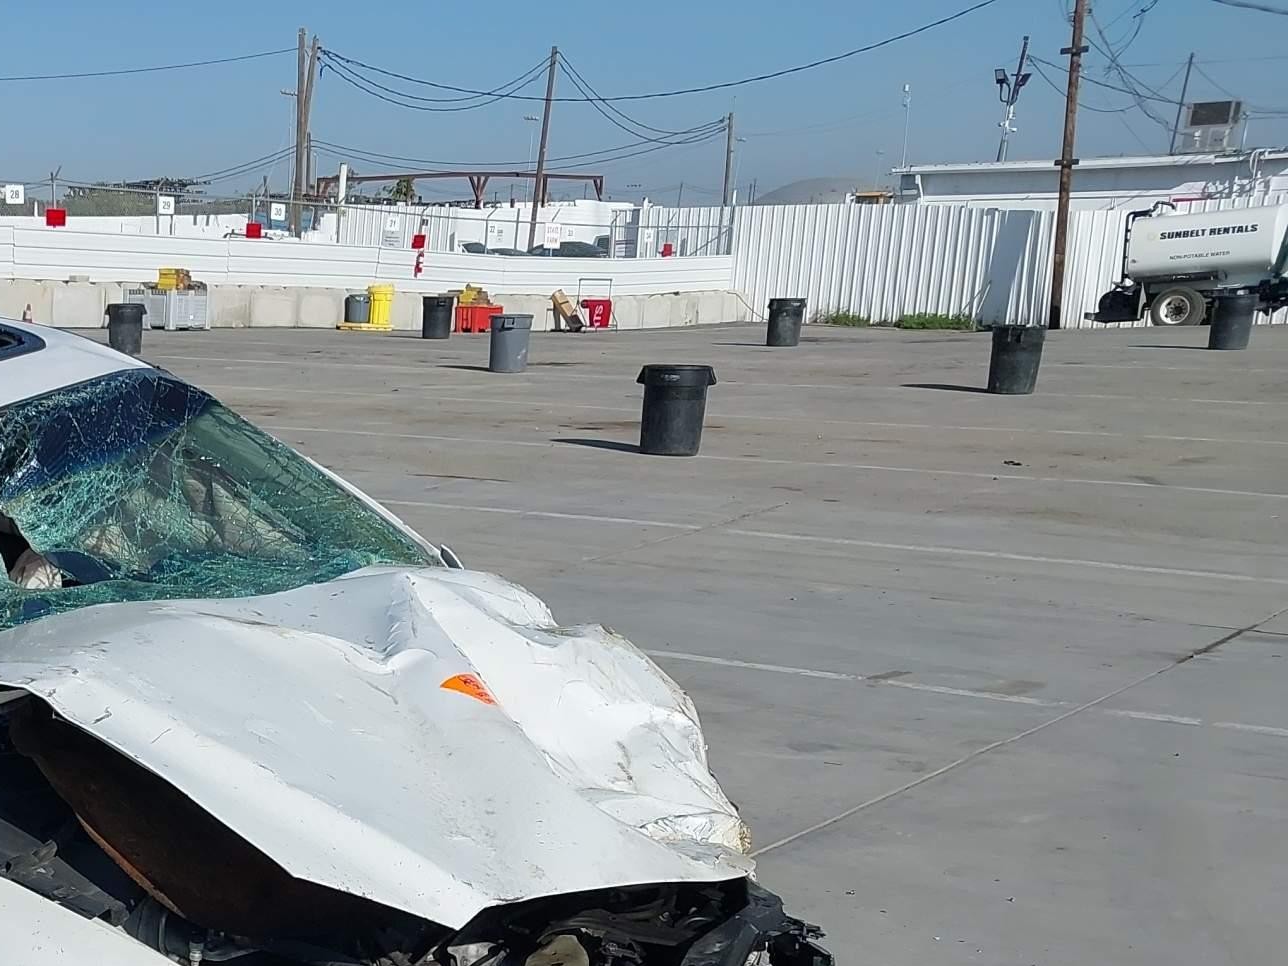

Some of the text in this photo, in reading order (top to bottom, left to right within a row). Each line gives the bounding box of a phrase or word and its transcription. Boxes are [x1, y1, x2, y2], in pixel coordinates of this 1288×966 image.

[10, 189, 20, 199] 28
[162, 200, 171, 210] 29
[1160, 224, 1259, 240] SUNBELT RENTALS
